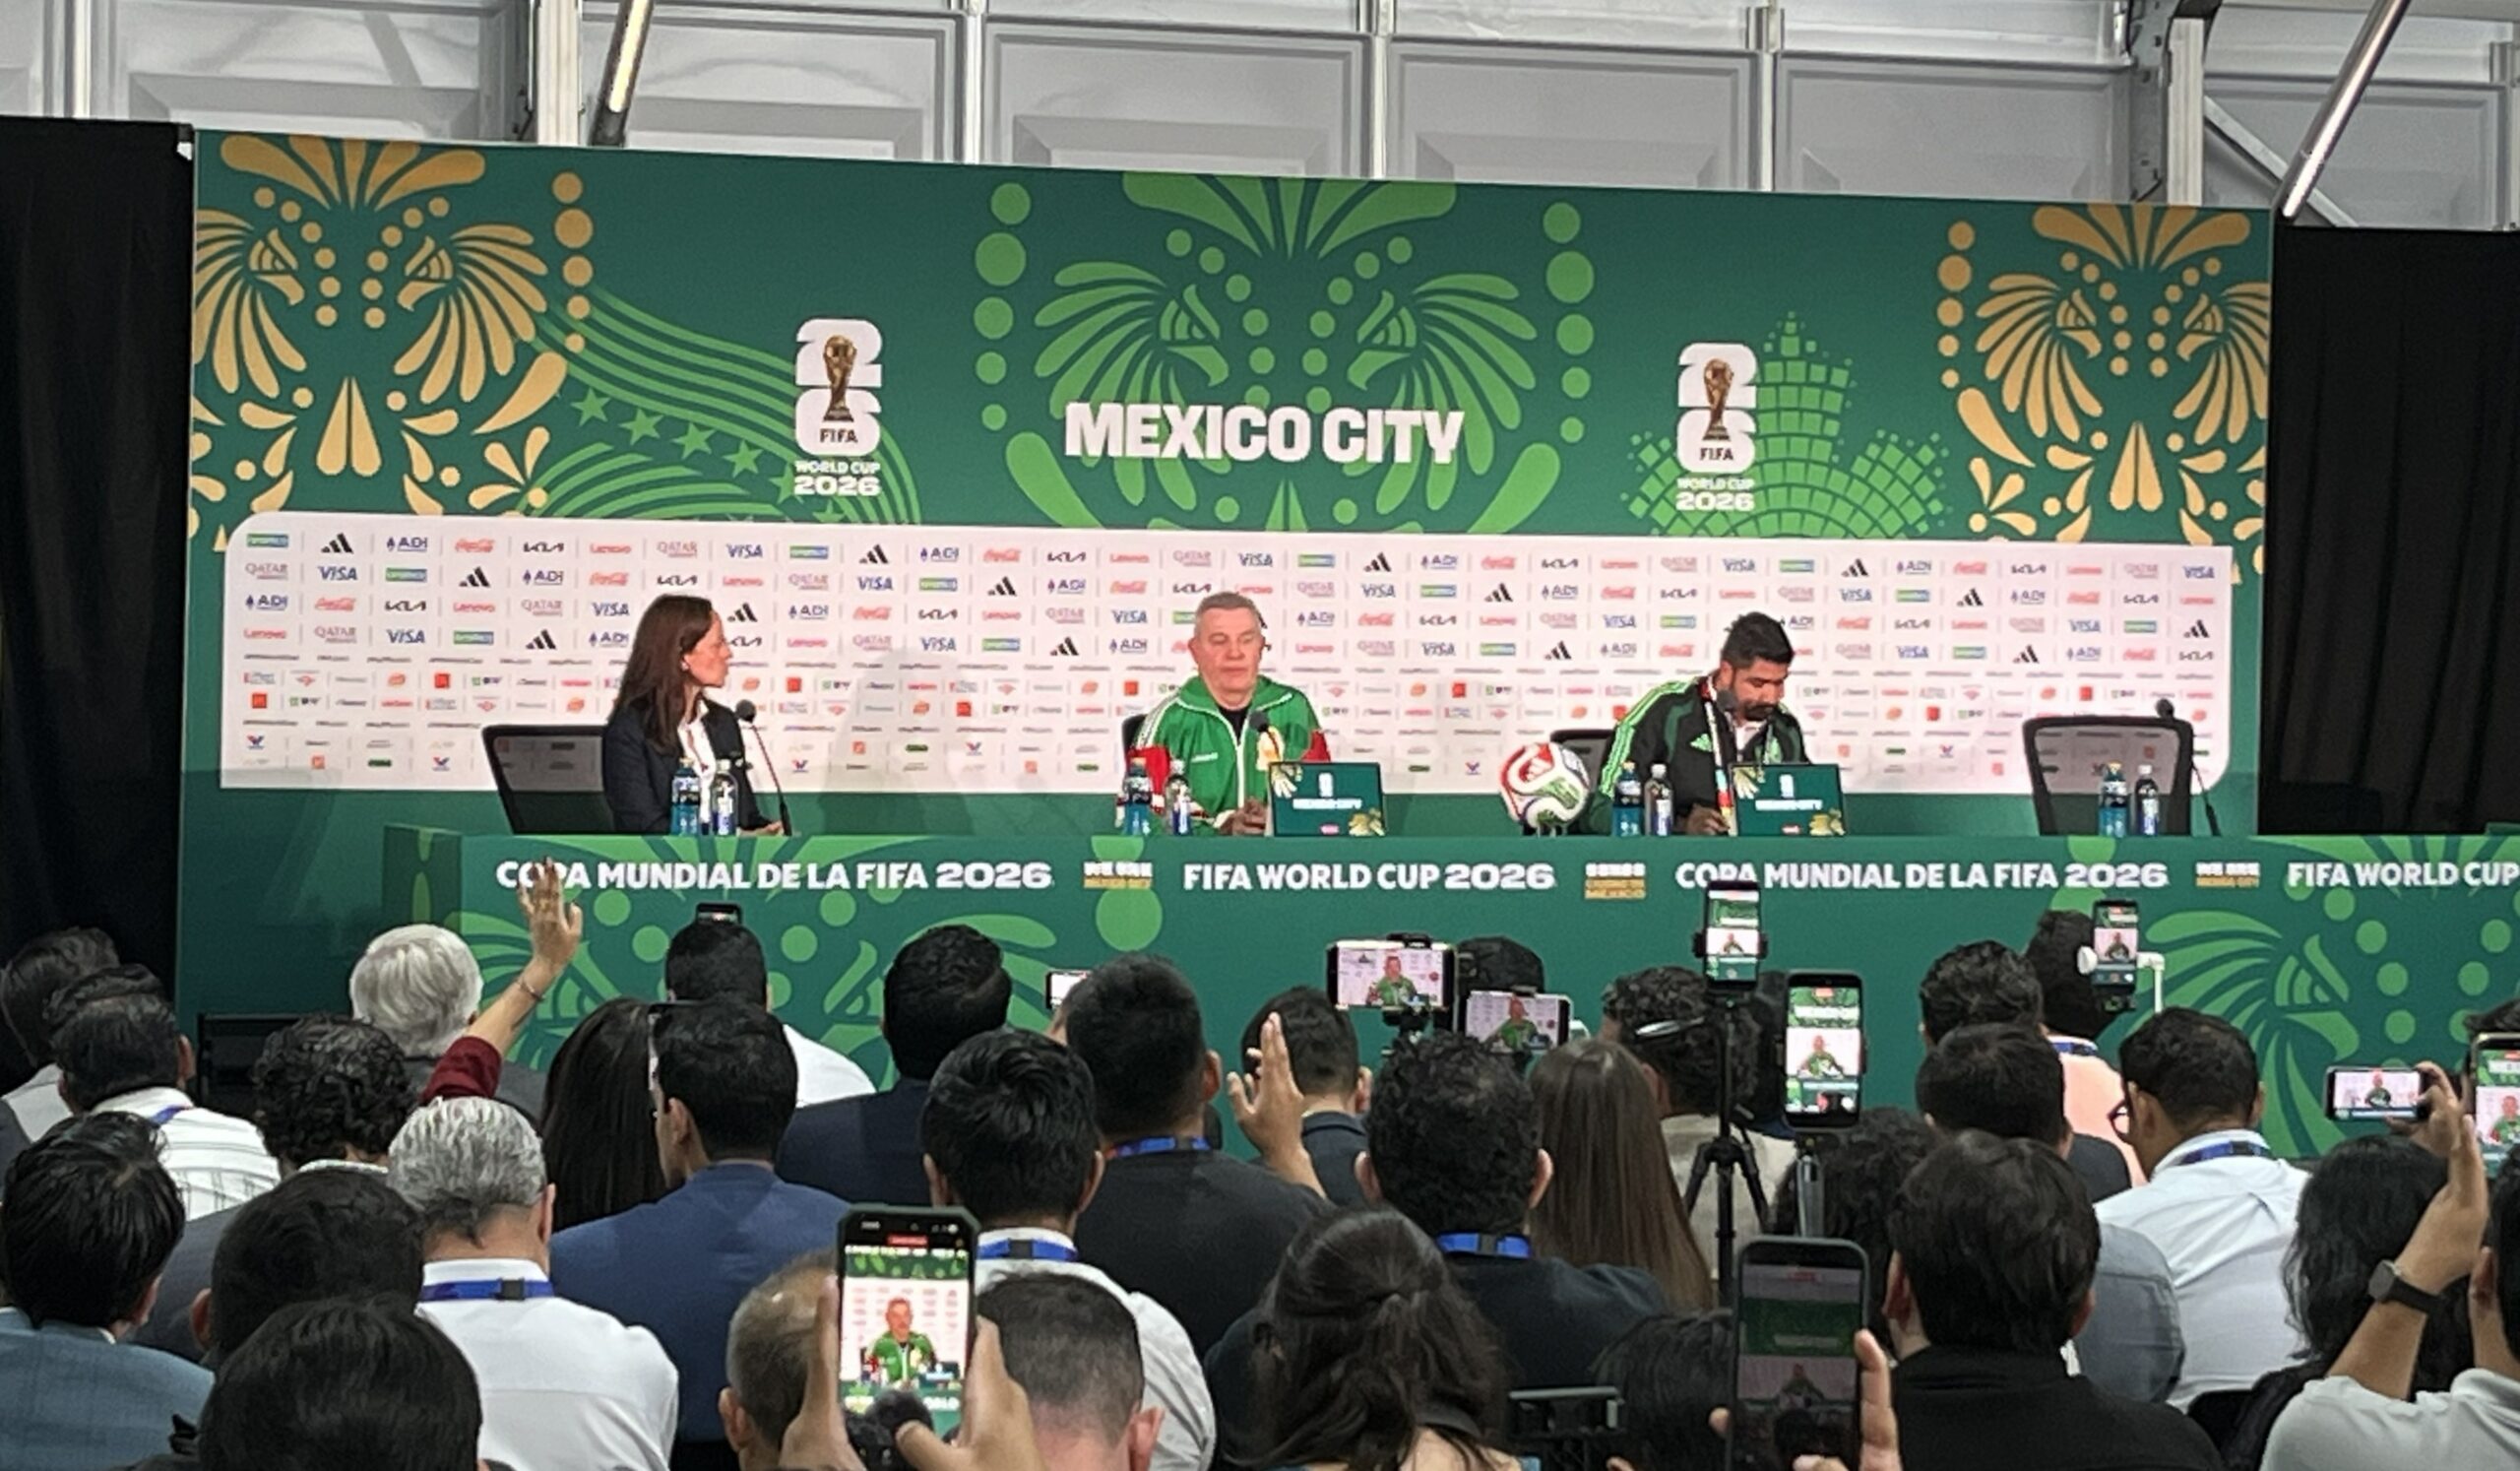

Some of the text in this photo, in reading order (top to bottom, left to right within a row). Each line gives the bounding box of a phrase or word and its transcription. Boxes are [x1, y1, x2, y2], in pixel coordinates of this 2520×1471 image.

[820, 428, 857, 443] FIFA
[1065, 402, 1465, 464] MEXICO CITY
[1700, 447, 1733, 461] FIFA
[794, 460, 880, 474] WORLD CUP
[794, 475, 880, 496] 2026
[1676, 478, 1754, 490] WORLD CUP
[1675, 491, 1754, 512] 2026
[657, 542, 697, 551] QATAR
[726, 544, 763, 558] VISA
[1238, 553, 1273, 566] VISA
[245, 563, 288, 574] QATAR
[318, 566, 357, 581] VISA
[857, 577, 893, 591] VISA
[521, 600, 562, 609] QATAR
[593, 603, 629, 616] VISA
[1112, 610, 1147, 623] VISA
[314, 626, 356, 636] QATAR
[387, 629, 425, 643] VISA
[920, 637, 956, 651] VISA
[598, 862, 751, 888] MUNDIAL
[758, 863, 800, 889] DE
[807, 863, 850, 889] LA
[857, 863, 928, 889] FIFA
[936, 863, 1052, 889] 2026
[1184, 863, 1251, 889] FIFA
[1257, 863, 1371, 889] WORLD
[1377, 863, 1440, 889] CUP
[1445, 863, 1555, 889] 2026
[1675, 863, 1757, 888] COPA
[1764, 863, 1900, 888] MUNDIAL
[1906, 863, 1944, 888] DE
[1950, 863, 1988, 888] LA
[1993, 863, 2058, 888] FIFA
[2065, 863, 2168, 888] 2026
[2288, 863, 2351, 886] FIFA
[2354, 863, 2459, 886] WORLD
[2464, 862, 2520, 886] CUP
